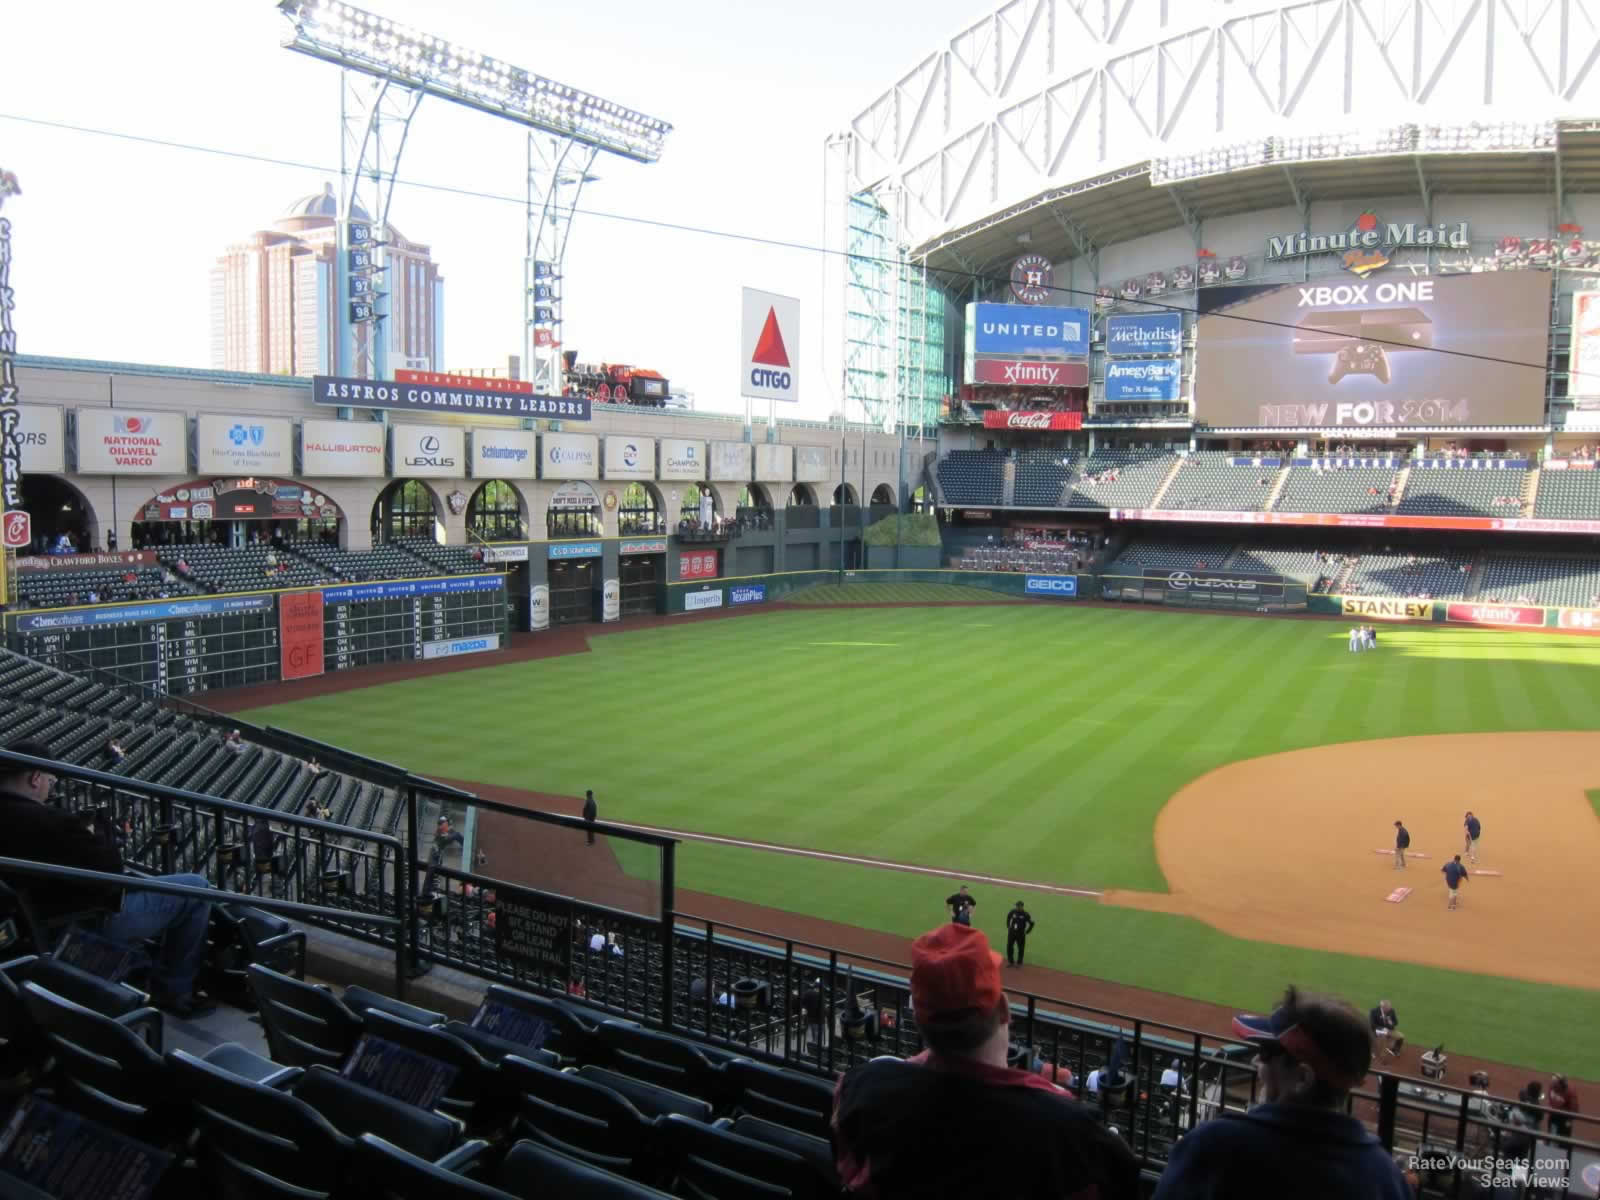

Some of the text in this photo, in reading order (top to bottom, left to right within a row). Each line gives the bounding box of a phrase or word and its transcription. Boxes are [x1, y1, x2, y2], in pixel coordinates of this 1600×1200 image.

[355, 228, 369, 240] 80
[1266, 222, 1471, 260] Minute Maid
[355, 254, 369, 266] 86
[355, 281, 368, 292] 97
[1026, 271, 1043, 289] H
[1298, 281, 1434, 307] XBOX ONE
[356, 306, 369, 317] 98
[983, 322, 1058, 337] UNITED
[1111, 327, 1177, 342] Methodist
[750, 368, 791, 390] CITGO
[1004, 363, 1060, 384] xfinity
[327, 383, 584, 415] ASTROS COMMUNITY LEADERS
[1007, 412, 1053, 428] Coca-Cola
[1259, 399, 1469, 426] NEW FOR 2014
[103, 436, 162, 447] NATIONAL
[306, 443, 382, 454] HALLIBURTON
[2, 411, 21, 505] FARE
[108, 447, 158, 457] OILWELL
[481, 445, 529, 463] Schlumberger
[115, 457, 153, 467] VARCO
[404, 456, 455, 467] LEXUS
[51, 556, 96, 567] CRAWFORD
[1027, 578, 1074, 591] GEICO
[1194, 578, 1256, 590] LEXUS
[731, 590, 763, 603] TexanPlus
[1343, 599, 1428, 617] STANLEY
[1471, 606, 1521, 623] xfinity
[451, 639, 488, 653] mazda
[158, 626, 168, 695] NATIONAL
